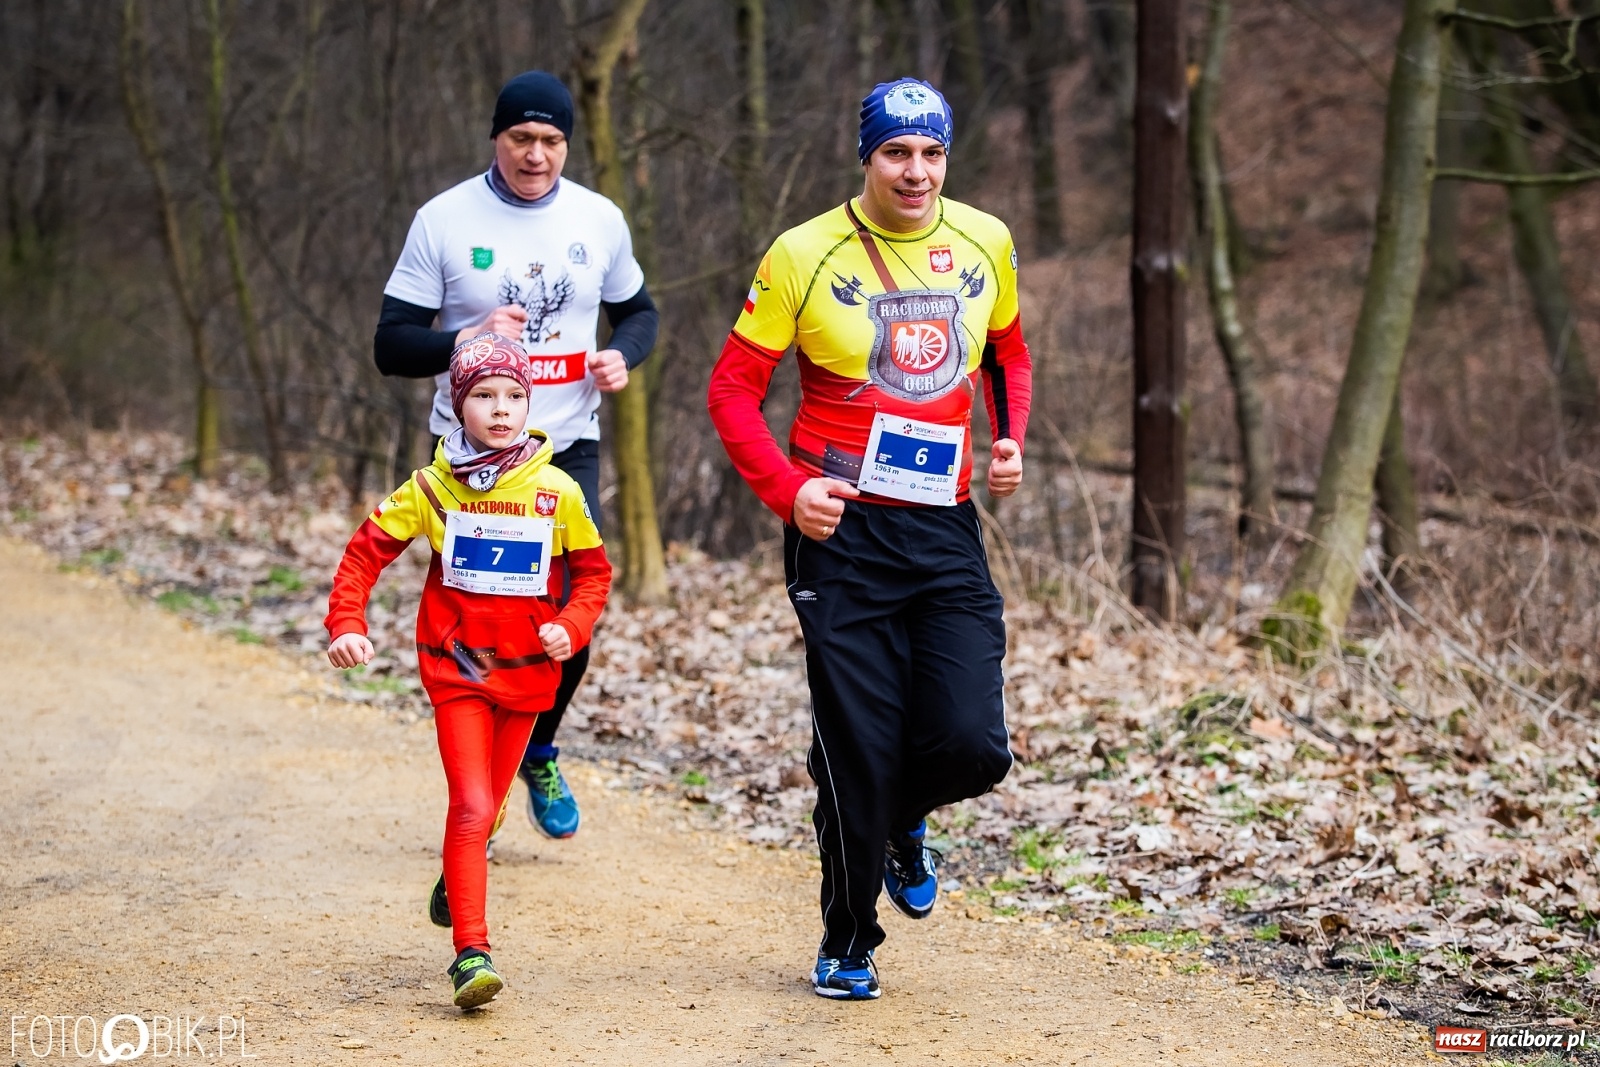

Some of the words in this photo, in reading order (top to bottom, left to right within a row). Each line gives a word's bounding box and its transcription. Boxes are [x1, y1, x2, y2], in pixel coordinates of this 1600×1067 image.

[880, 301, 957, 316] RACIBORKI
[531, 360, 567, 380] SKA
[904, 376, 935, 392] OCR
[915, 447, 929, 465] 6
[874, 464, 892, 474] 1963
[460, 500, 526, 517] RACIBORKI
[491, 547, 505, 565] 7
[453, 569, 469, 577] 1963
